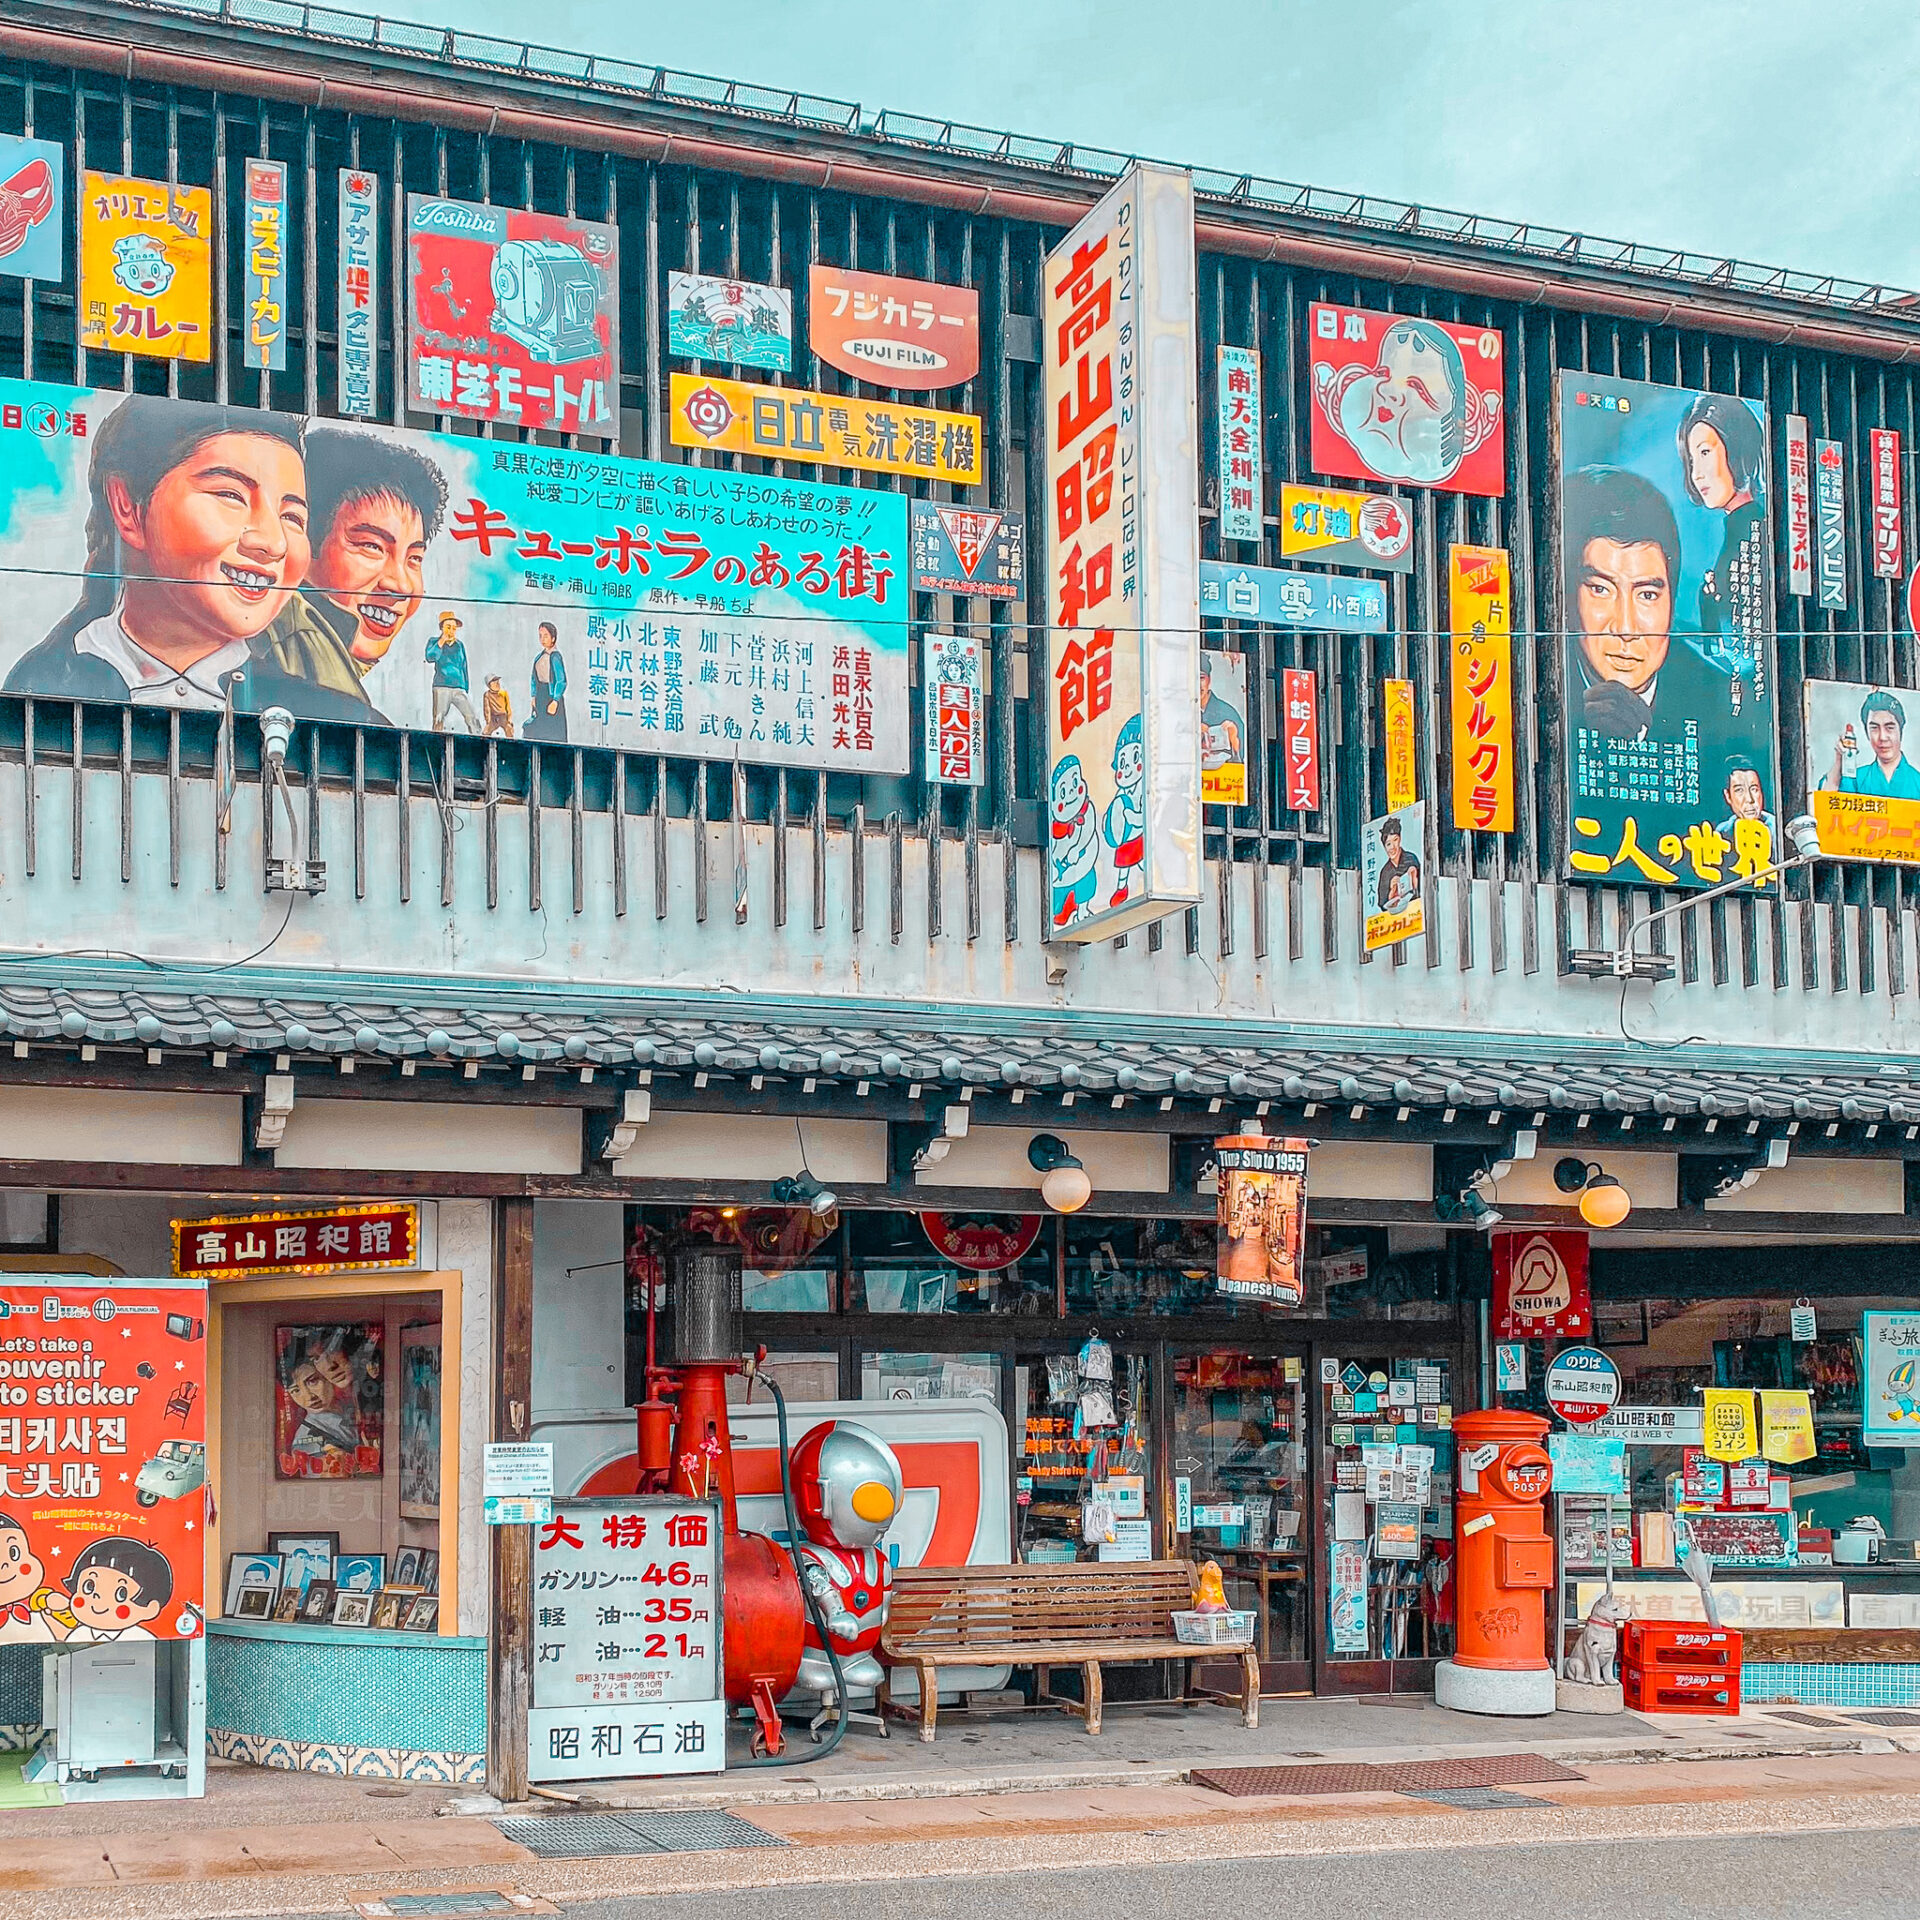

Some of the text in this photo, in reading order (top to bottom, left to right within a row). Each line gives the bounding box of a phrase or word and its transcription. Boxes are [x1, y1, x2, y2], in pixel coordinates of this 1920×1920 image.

[414, 202, 496, 233] Toshiba
[89, 300, 107, 336] 即席
[112, 302, 200, 341] カレー
[824, 286, 964, 331] フジカラー
[853, 342, 936, 366] FUJI FILM
[1317, 309, 1500, 360] 日本 一の
[419, 356, 611, 423] 東芝モートル
[1118, 202, 1136, 603] わくわく るんるん レトロな世界
[753, 397, 975, 472] 日立電気洗濯機
[1055, 234, 1117, 742] 高山昭和館
[1292, 501, 1352, 538] 灯油
[448, 498, 897, 604] キューポラのある街
[1821, 501, 1845, 603] ラクピス
[1226, 571, 1319, 620] 白雪
[612, 622, 633, 719] 小沢昭一
[638, 621, 659, 731] 北林谷栄
[662, 625, 684, 733] 東野英治郎
[794, 640, 815, 748] 河上信夫
[832, 644, 851, 750] 浜田光夫
[854, 647, 875, 752] 吉永小百合
[940, 685, 969, 779] 美人わた
[1290, 699, 1314, 810] 蛇ノ目ソース
[1465, 658, 1500, 829] シルク号
[1684, 719, 1700, 806] 石原裕次郎
[1569, 816, 1778, 889] 二人の世界
[1828, 814, 1920, 848] ハイアー
[1276, 1153, 1305, 1172] 1955
[195, 1219, 393, 1265] 高山昭和館
[1514, 1296, 1562, 1310] SHOWA
[0, 1337, 93, 1352] et's take a
[1566, 1356, 1602, 1370] のりば
[36, 1380, 139, 1406] sticker
[1552, 1378, 1614, 1395] 高山昭和館
[1562, 1403, 1600, 1415] 高山バス
[1601, 1411, 1676, 1427] 高山昭和館
[1642, 1429, 1661, 1439] WEB
[1662, 1429, 1674, 1439] で
[1713, 1440, 1747, 1449] コイン
[0, 1462, 101, 1499] 大头贴
[1513, 1482, 1542, 1493] POST
[1178, 1482, 1189, 1528] 出入り口
[538, 1514, 710, 1551] 大特価
[1744, 1595, 1808, 1624] 玩具
[549, 1720, 705, 1761] 昭和石油
